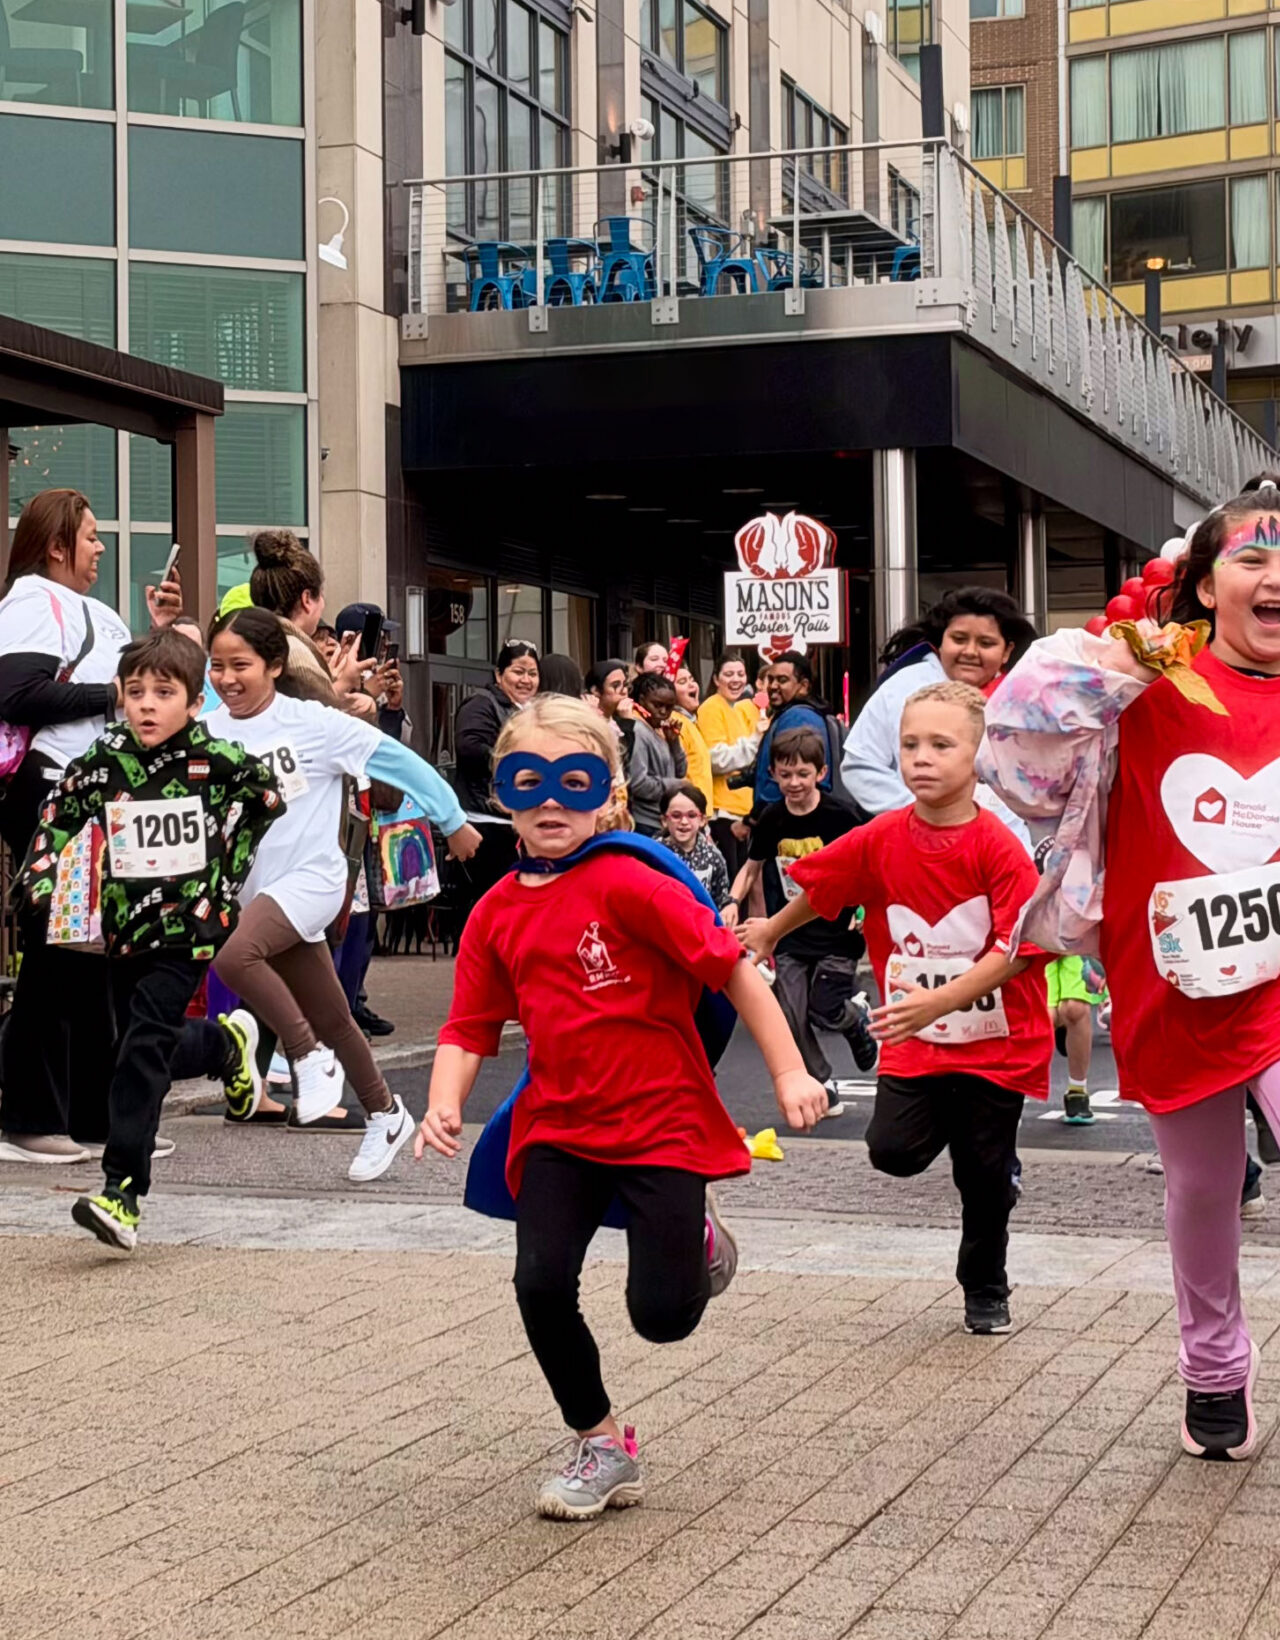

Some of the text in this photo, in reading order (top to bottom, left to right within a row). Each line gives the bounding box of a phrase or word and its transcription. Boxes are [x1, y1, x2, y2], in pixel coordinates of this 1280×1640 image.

[735, 580, 830, 613] MASON'S
[450, 603, 465, 625] 158
[736, 612, 830, 639] Lobster Rolls
[1232, 810, 1280, 823] McDonald
[1233, 800, 1267, 812] Ronald
[133, 810, 200, 848] 1205
[1231, 819, 1263, 830] House
